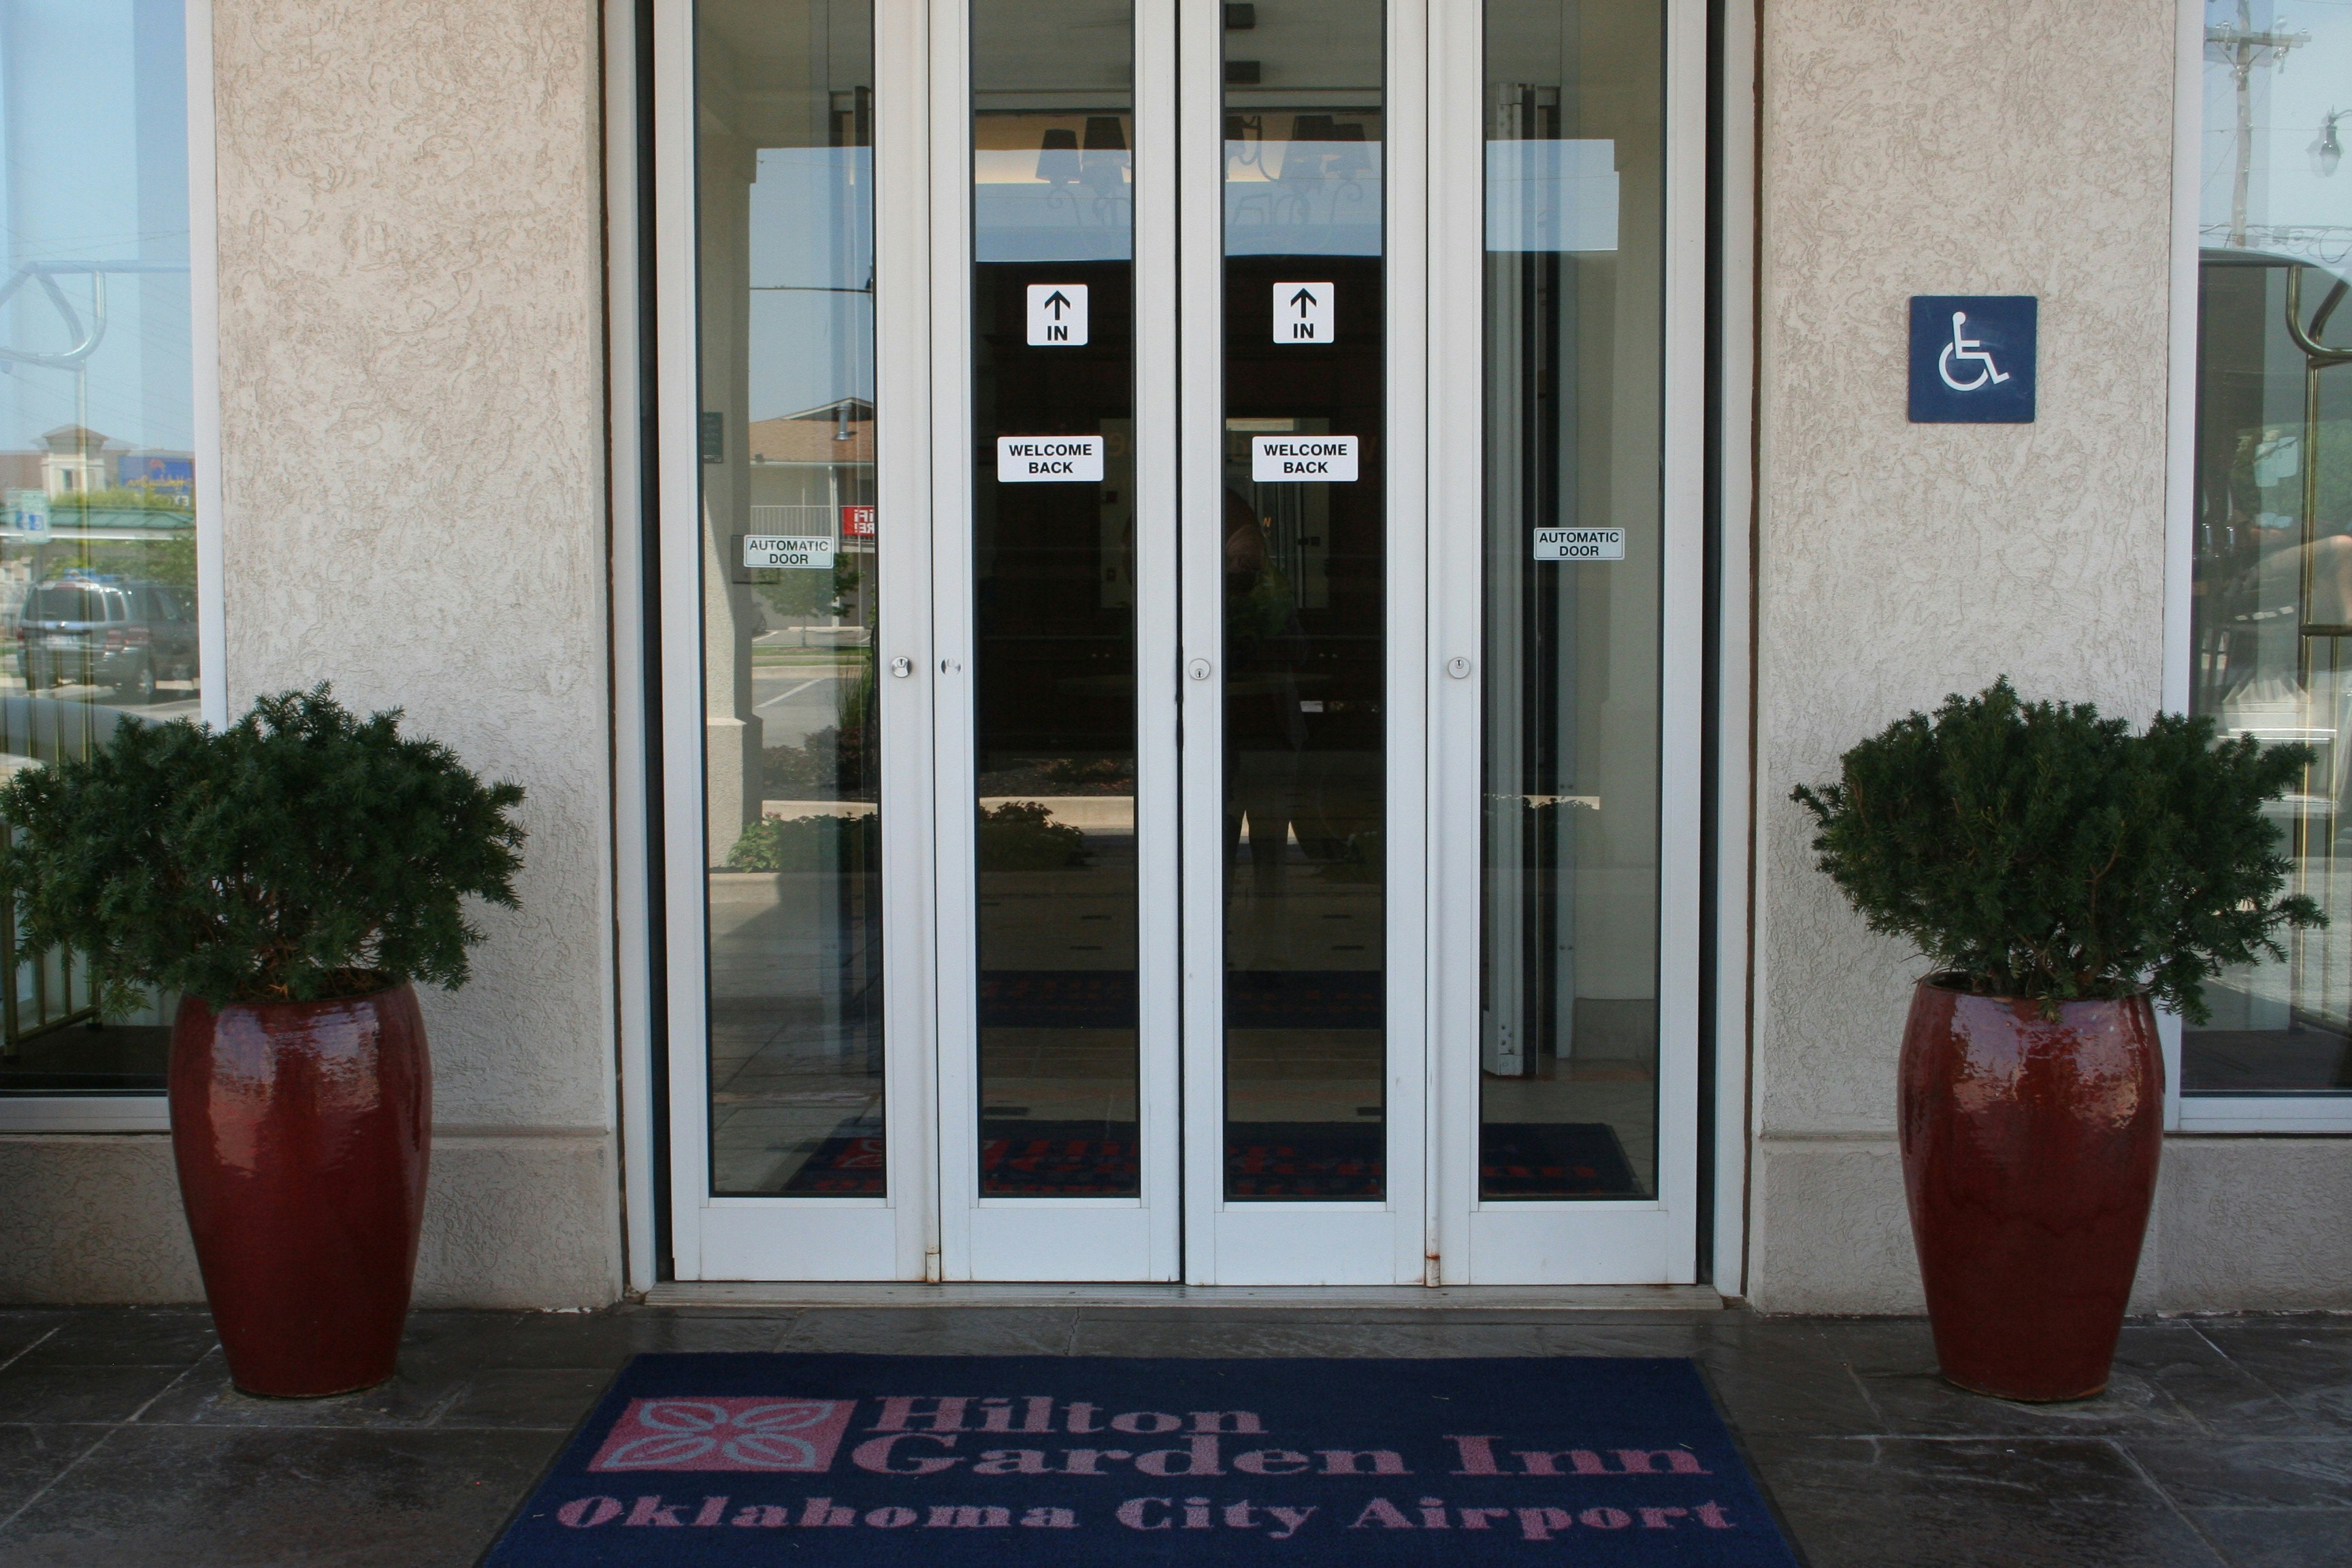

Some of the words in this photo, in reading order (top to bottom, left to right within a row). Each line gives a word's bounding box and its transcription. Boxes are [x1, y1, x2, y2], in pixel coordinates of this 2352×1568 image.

[1047, 325, 1068, 341] IN
[1293, 323, 1314, 339] IN
[1009, 444, 1092, 457] WELCOME
[1263, 444, 1348, 457] WELCOME
[1028, 461, 1073, 474] BACK
[1284, 461, 1328, 474] BACK
[1539, 532, 1619, 544] AUTOMATIC
[749, 540, 828, 552] AUTOMATIC
[1559, 545, 1599, 557] DOOR
[769, 553, 808, 565] DOOR
[863, 1396, 1269, 1433] Hilton
[851, 1433, 1414, 1475] Garden
[1443, 1435, 1713, 1475] Inn
[556, 1496, 1081, 1529] Oklahoma
[1115, 1497, 1318, 1539] City
[1346, 1497, 1737, 1541] Airport
